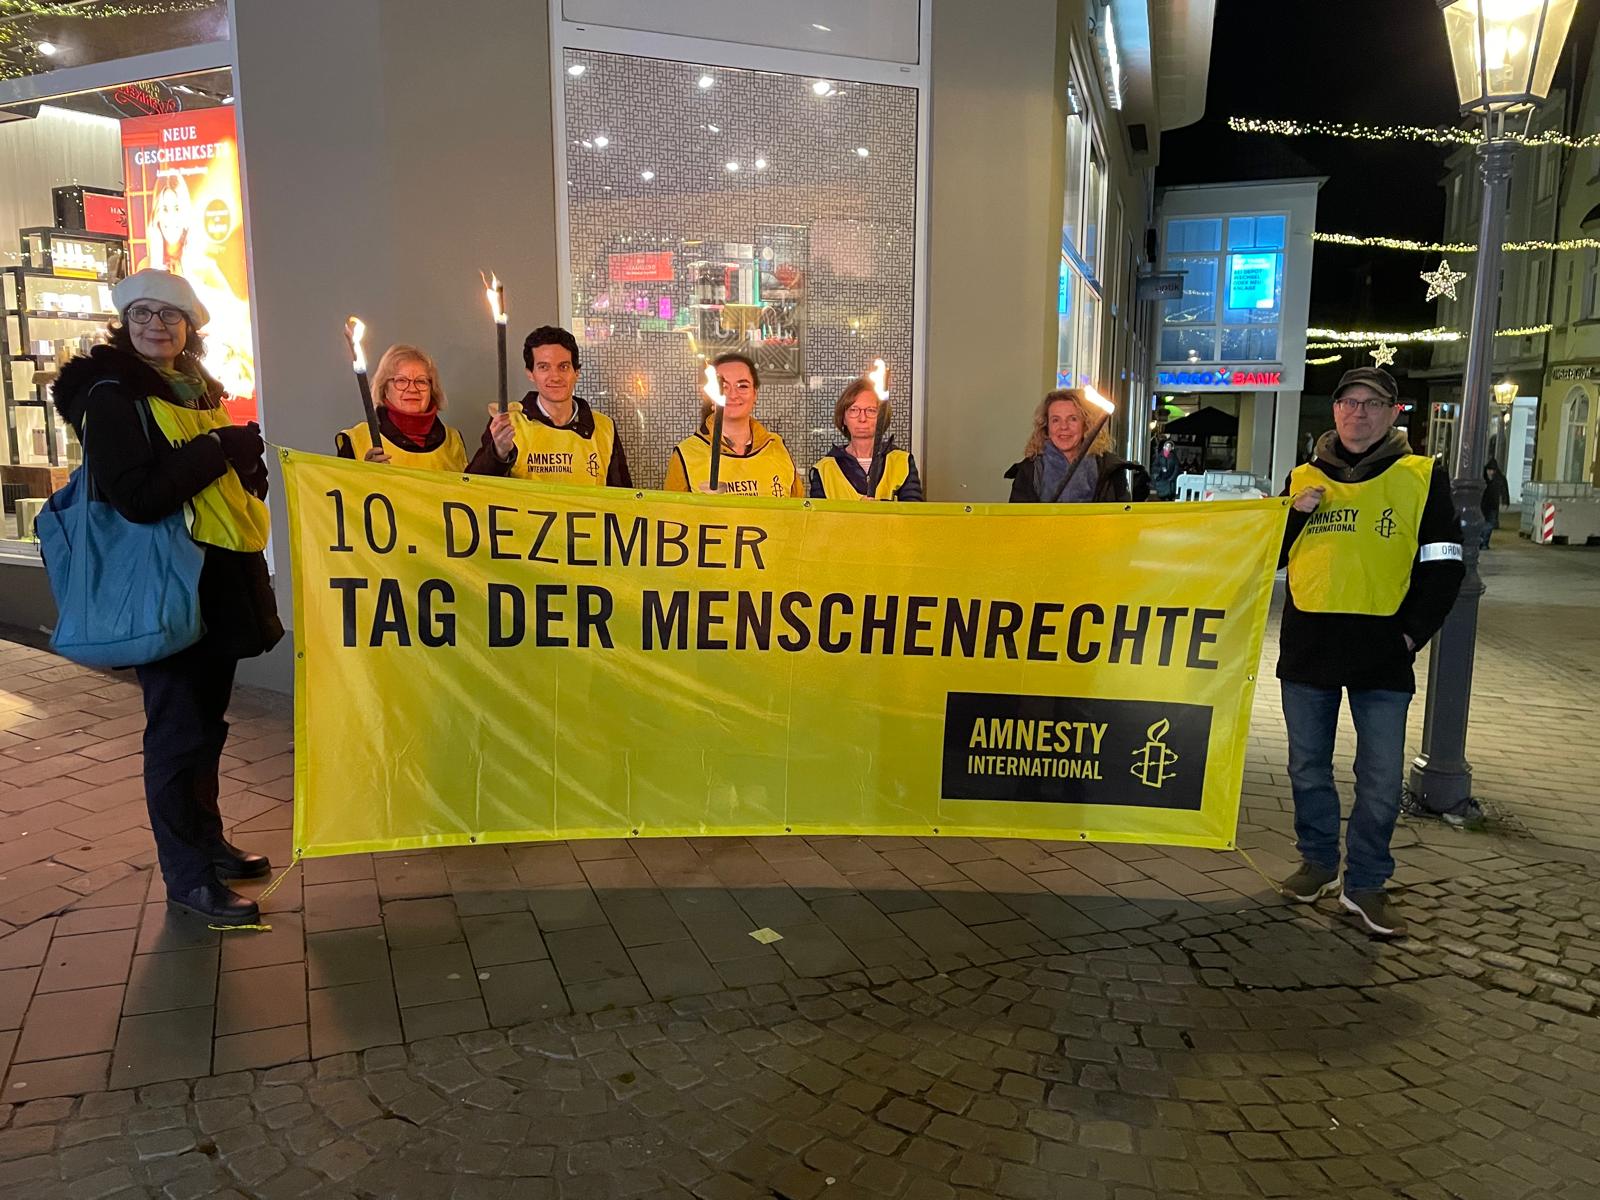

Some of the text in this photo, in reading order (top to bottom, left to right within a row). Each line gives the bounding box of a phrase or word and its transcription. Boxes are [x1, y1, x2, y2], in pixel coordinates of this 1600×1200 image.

[162, 126, 197, 142] NEUE
[1159, 372, 1280, 386] TARGO BANK
[527, 452, 573, 465] AMNESTY
[527, 465, 573, 474] INTERNATIONAL
[725, 480, 758, 493] NESTY
[1308, 508, 1359, 526] AMNESTY
[326, 488, 768, 571] 10. DEZEMBER
[329, 577, 1227, 670] TAG DER MENSCHENRECHTE
[968, 717, 1109, 756] AMNESTY
[967, 755, 1103, 781] INTERNATIONAL
